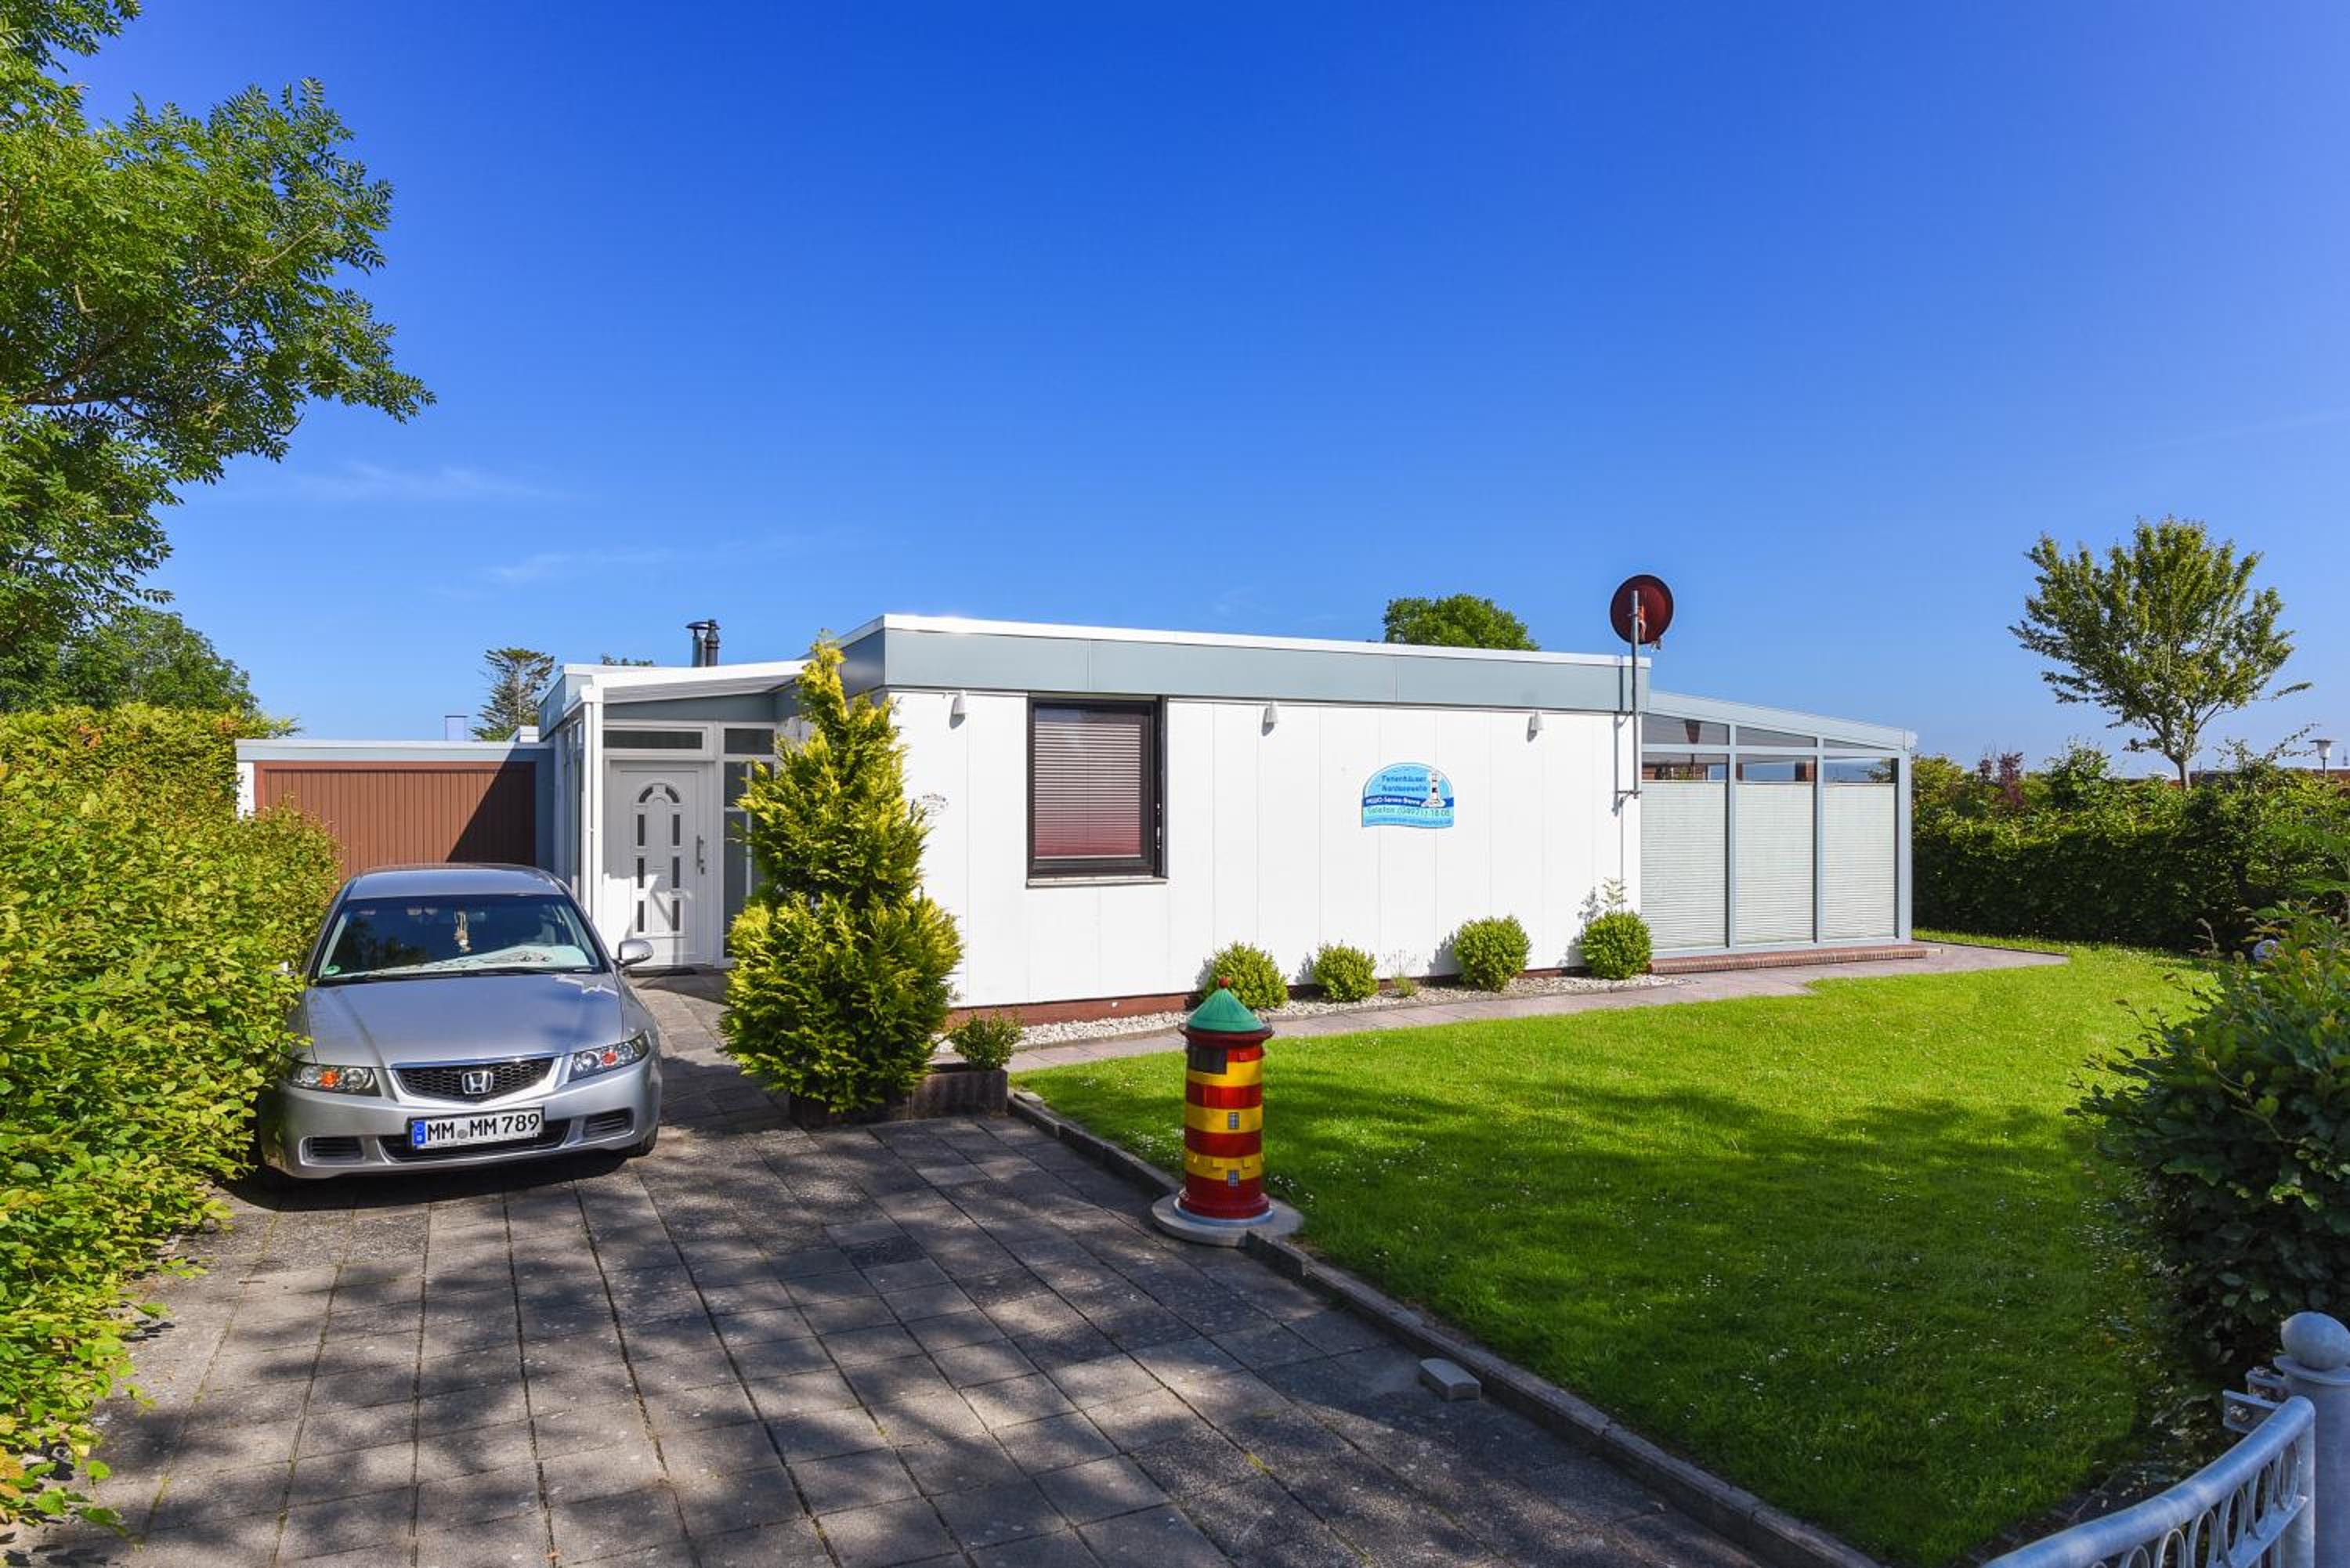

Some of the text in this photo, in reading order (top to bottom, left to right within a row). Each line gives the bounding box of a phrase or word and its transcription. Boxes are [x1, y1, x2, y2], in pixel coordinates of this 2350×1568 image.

[428, 1122, 454, 1141] MM
[469, 1118, 497, 1137] MM
[501, 1113, 540, 1133] 789
